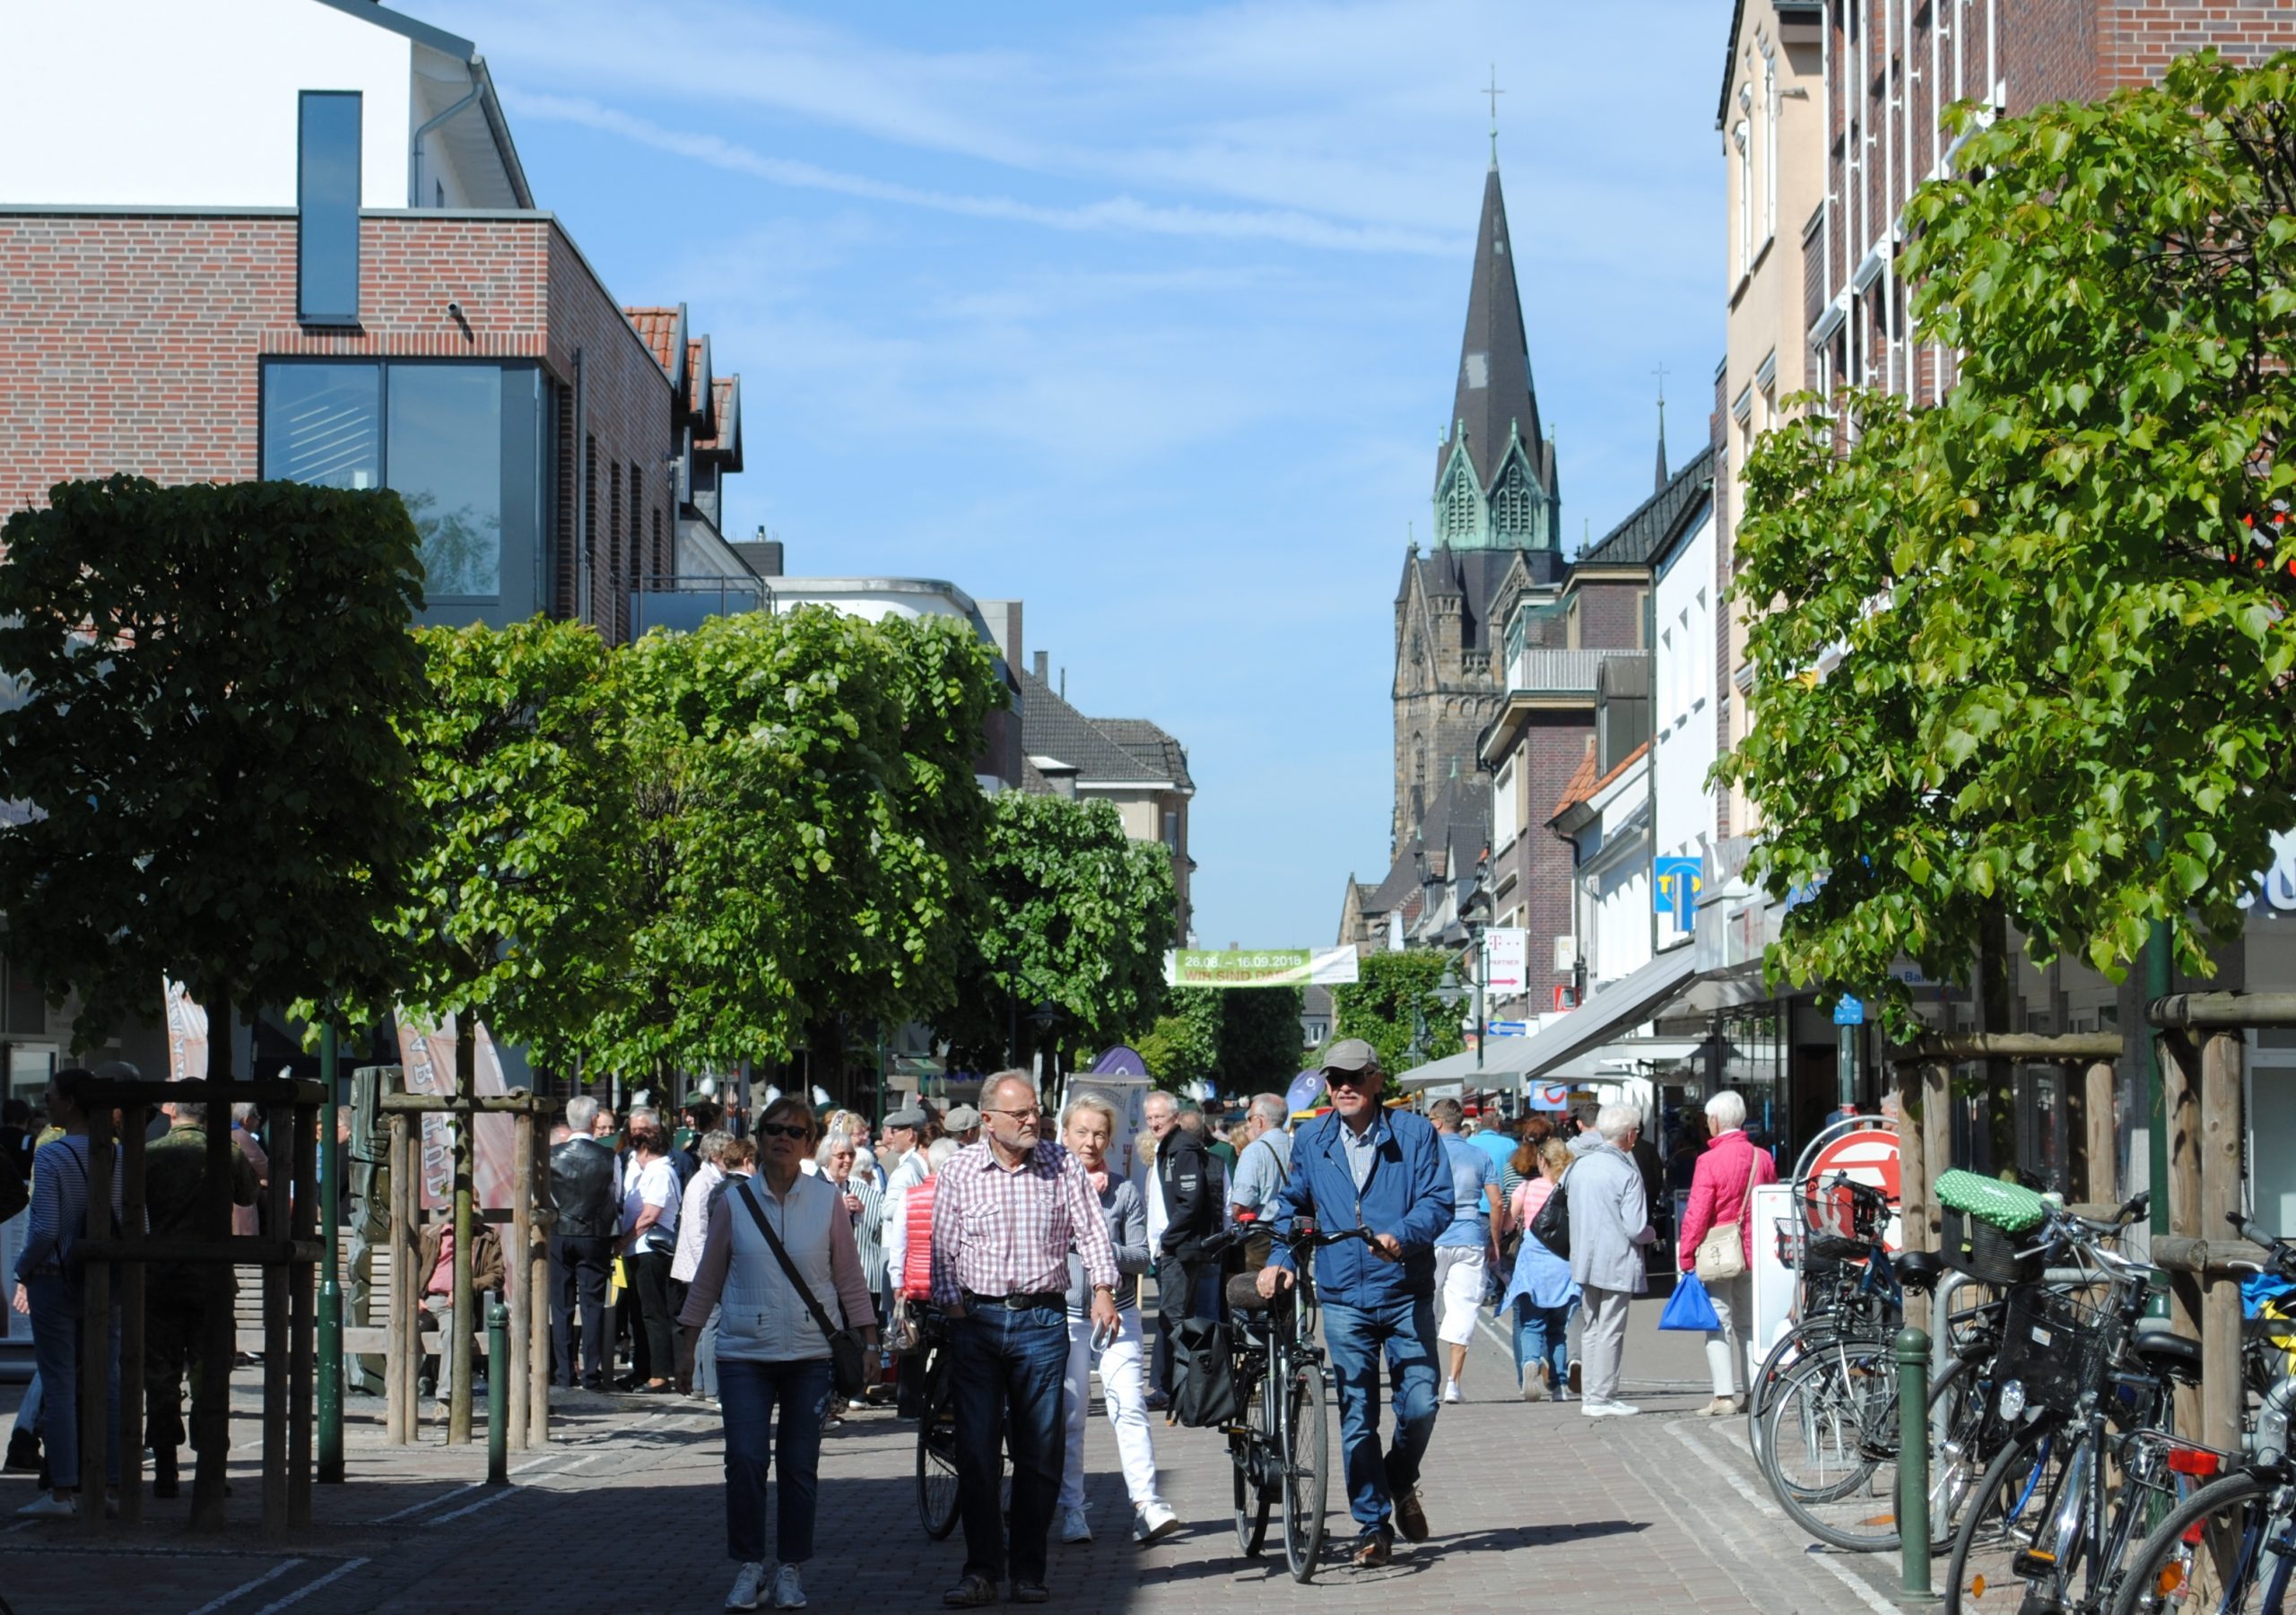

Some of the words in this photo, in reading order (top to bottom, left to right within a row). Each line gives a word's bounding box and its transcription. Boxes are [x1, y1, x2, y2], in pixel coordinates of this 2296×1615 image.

[1185, 956, 1222, 968] 26.08.
[1237, 955, 1303, 968] 16.09.2018
[1185, 969, 1212, 982] WIR
[1216, 969, 1251, 982] SIND
